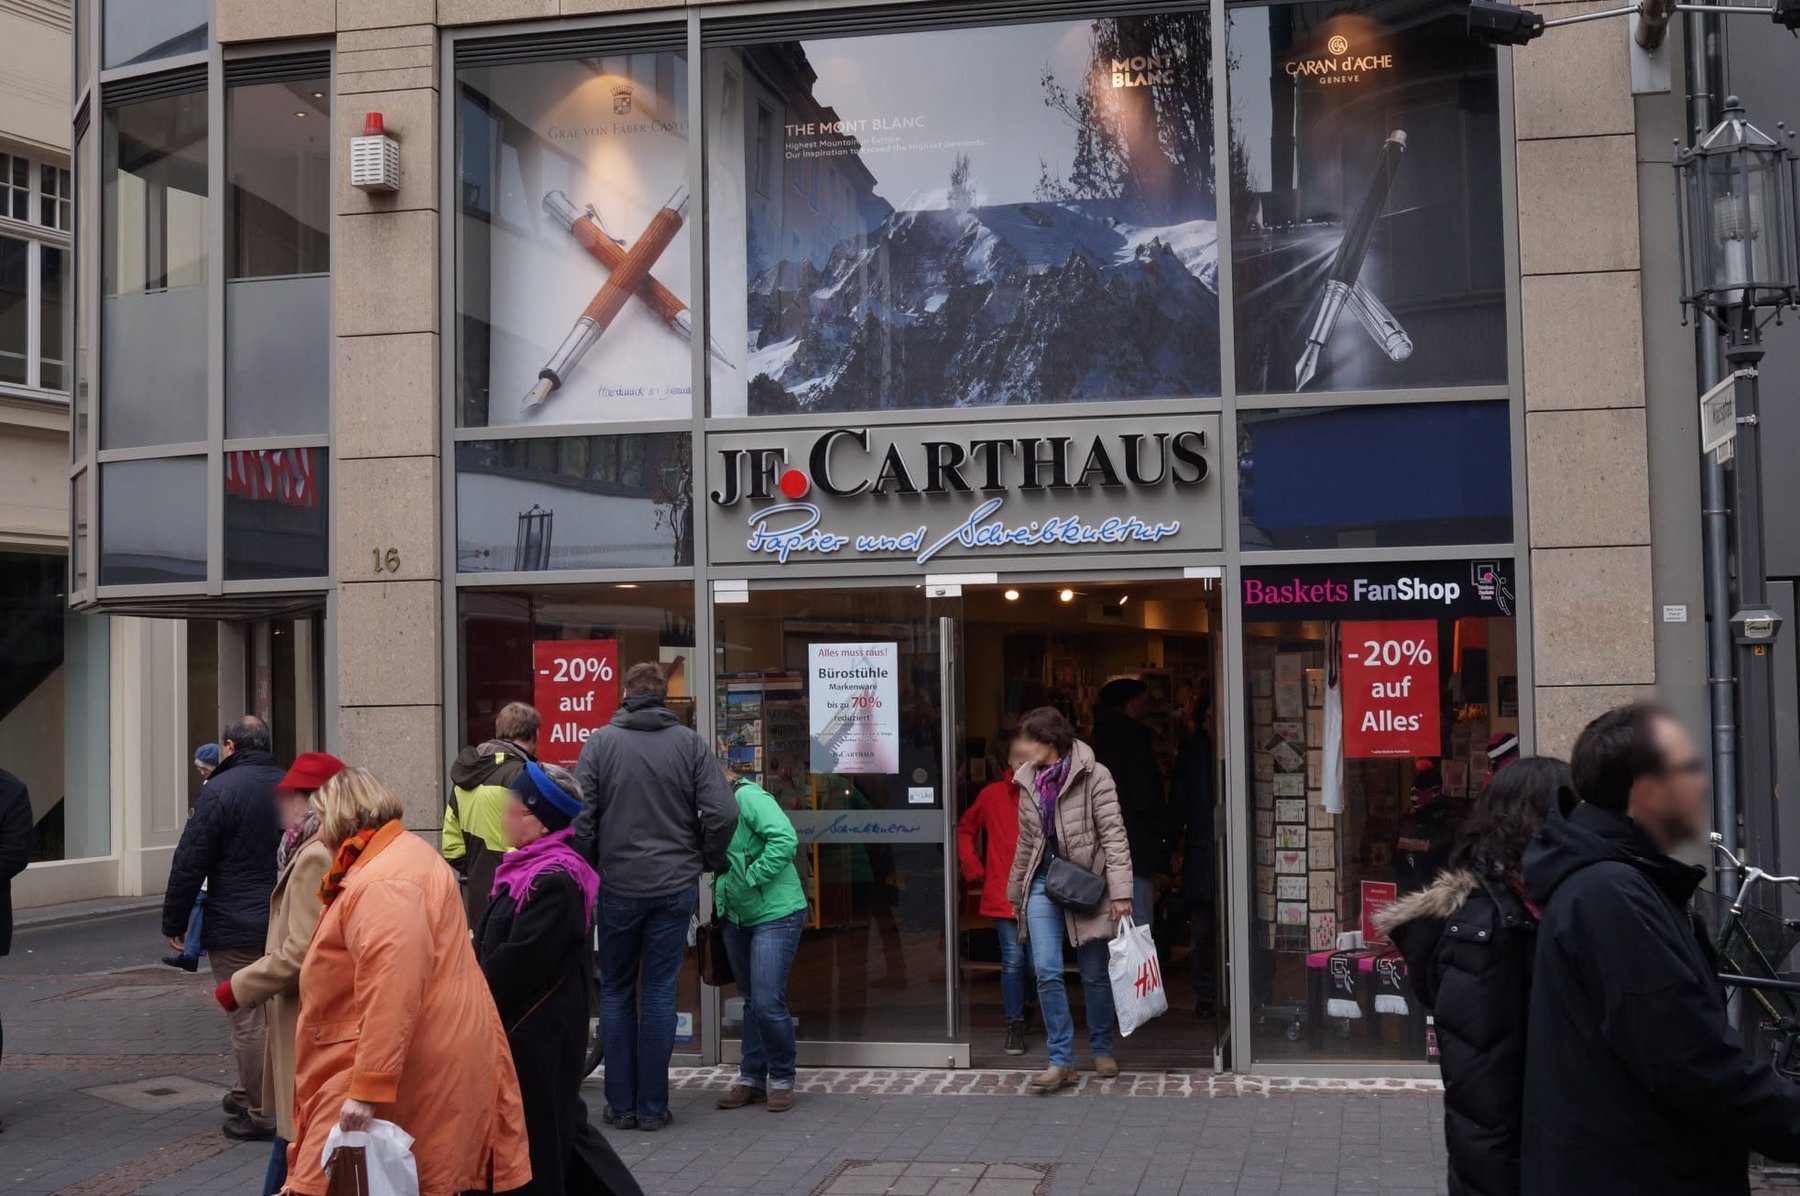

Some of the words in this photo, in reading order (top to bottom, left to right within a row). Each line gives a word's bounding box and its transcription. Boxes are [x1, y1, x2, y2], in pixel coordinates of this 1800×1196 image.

[1111, 54, 1173, 73] MONT
[1285, 58, 1337, 75] CARAN
[1342, 55, 1393, 71] d'ACHE
[1112, 70, 1175, 88] BLANC
[1319, 75, 1360, 84] GENEVE
[785, 123, 815, 137] THE
[820, 119, 869, 135] MONT
[872, 115, 925, 131] BLANC
[785, 140, 817, 151] Highest
[819, 138, 858, 148] Mountain
[785, 151, 801, 159] Our
[803, 147, 848, 159] Inspiration
[850, 146, 860, 154] to
[809, 429, 1209, 497] CARTHAUS
[747, 502, 849, 564] Papier
[856, 525, 927, 554] und
[917, 497, 1180, 564] Schreibkultur
[373, 547, 401, 573] 16
[1244, 578, 1349, 605] Baskets
[1353, 577, 1460, 604] FanShop
[818, 648, 839, 657] Alles
[841, 649, 864, 657] muss
[866, 648, 888, 657] raus!
[818, 667, 889, 679] Bürostühle
[829, 683, 878, 691] Markenware
[1371, 676, 1412, 698] auf
[559, 691, 595, 711] auf
[827, 701, 839, 709] bis
[851, 696, 883, 709] 70%
[550, 722, 600, 743] Alle
